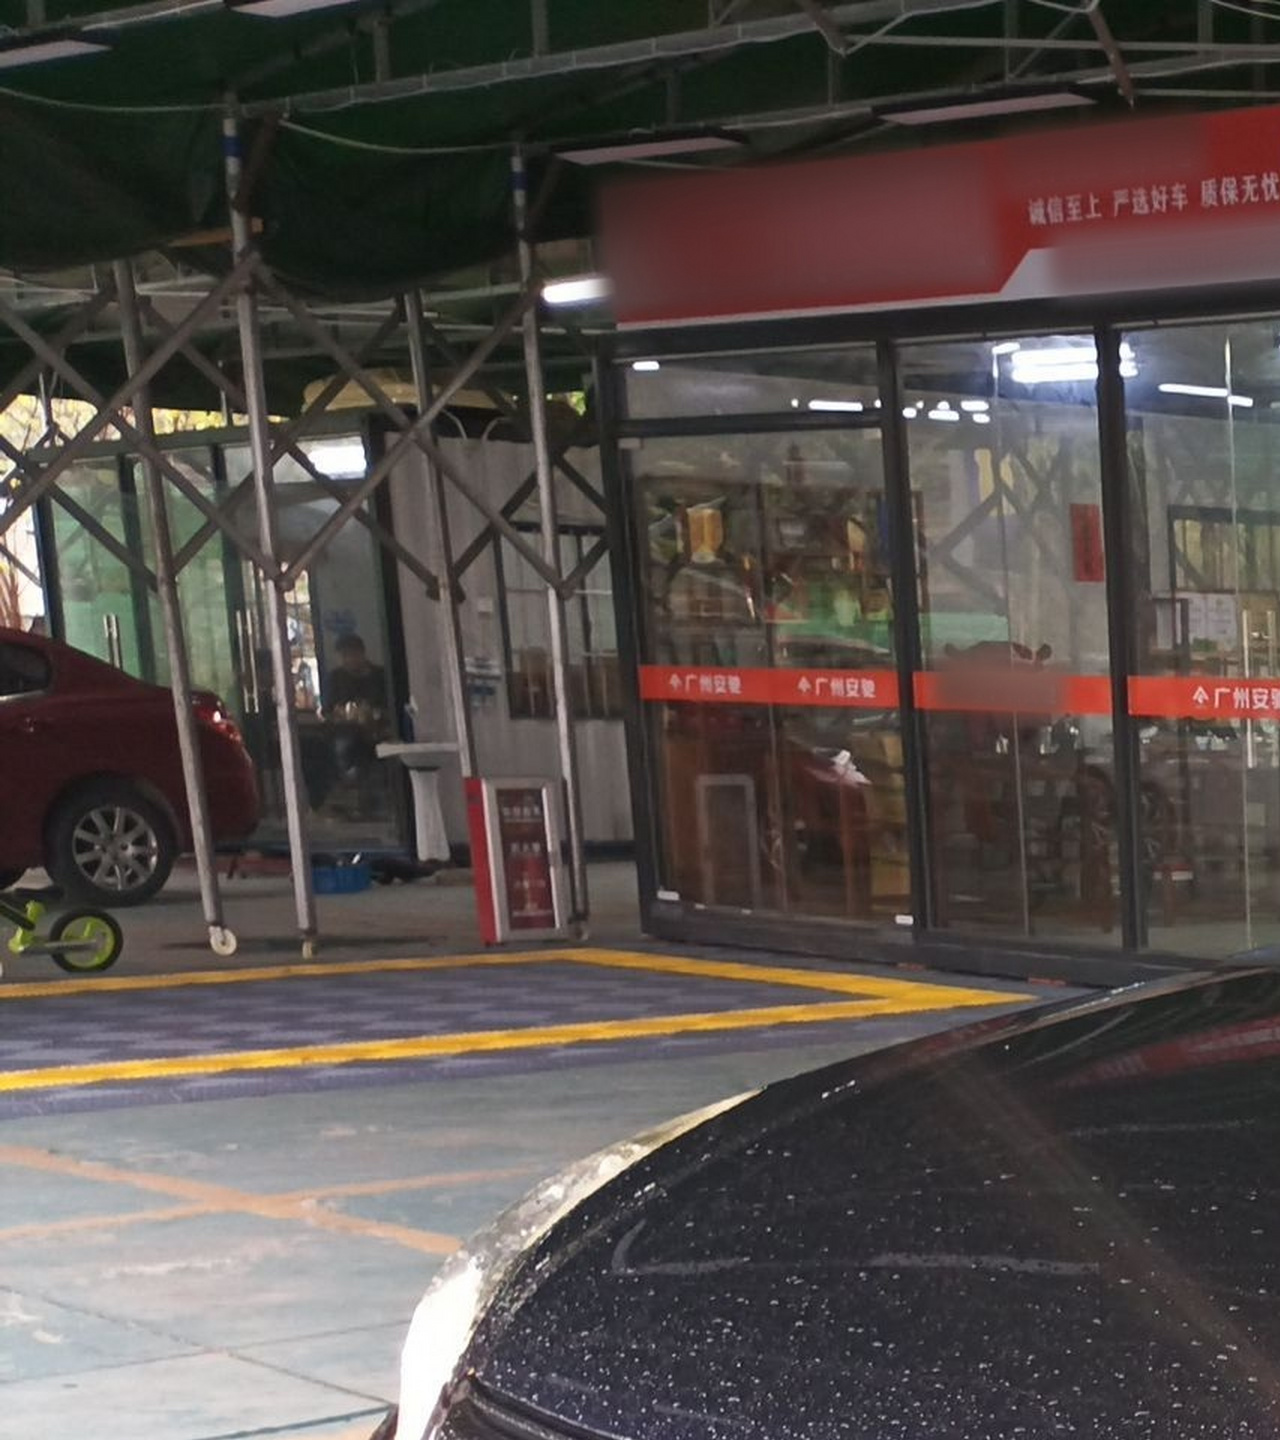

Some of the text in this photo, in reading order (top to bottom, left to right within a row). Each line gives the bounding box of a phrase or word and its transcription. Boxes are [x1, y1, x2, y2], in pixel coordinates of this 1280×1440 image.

[1028, 172, 1280, 226] 诚信至上 严选好车 质保无忧
